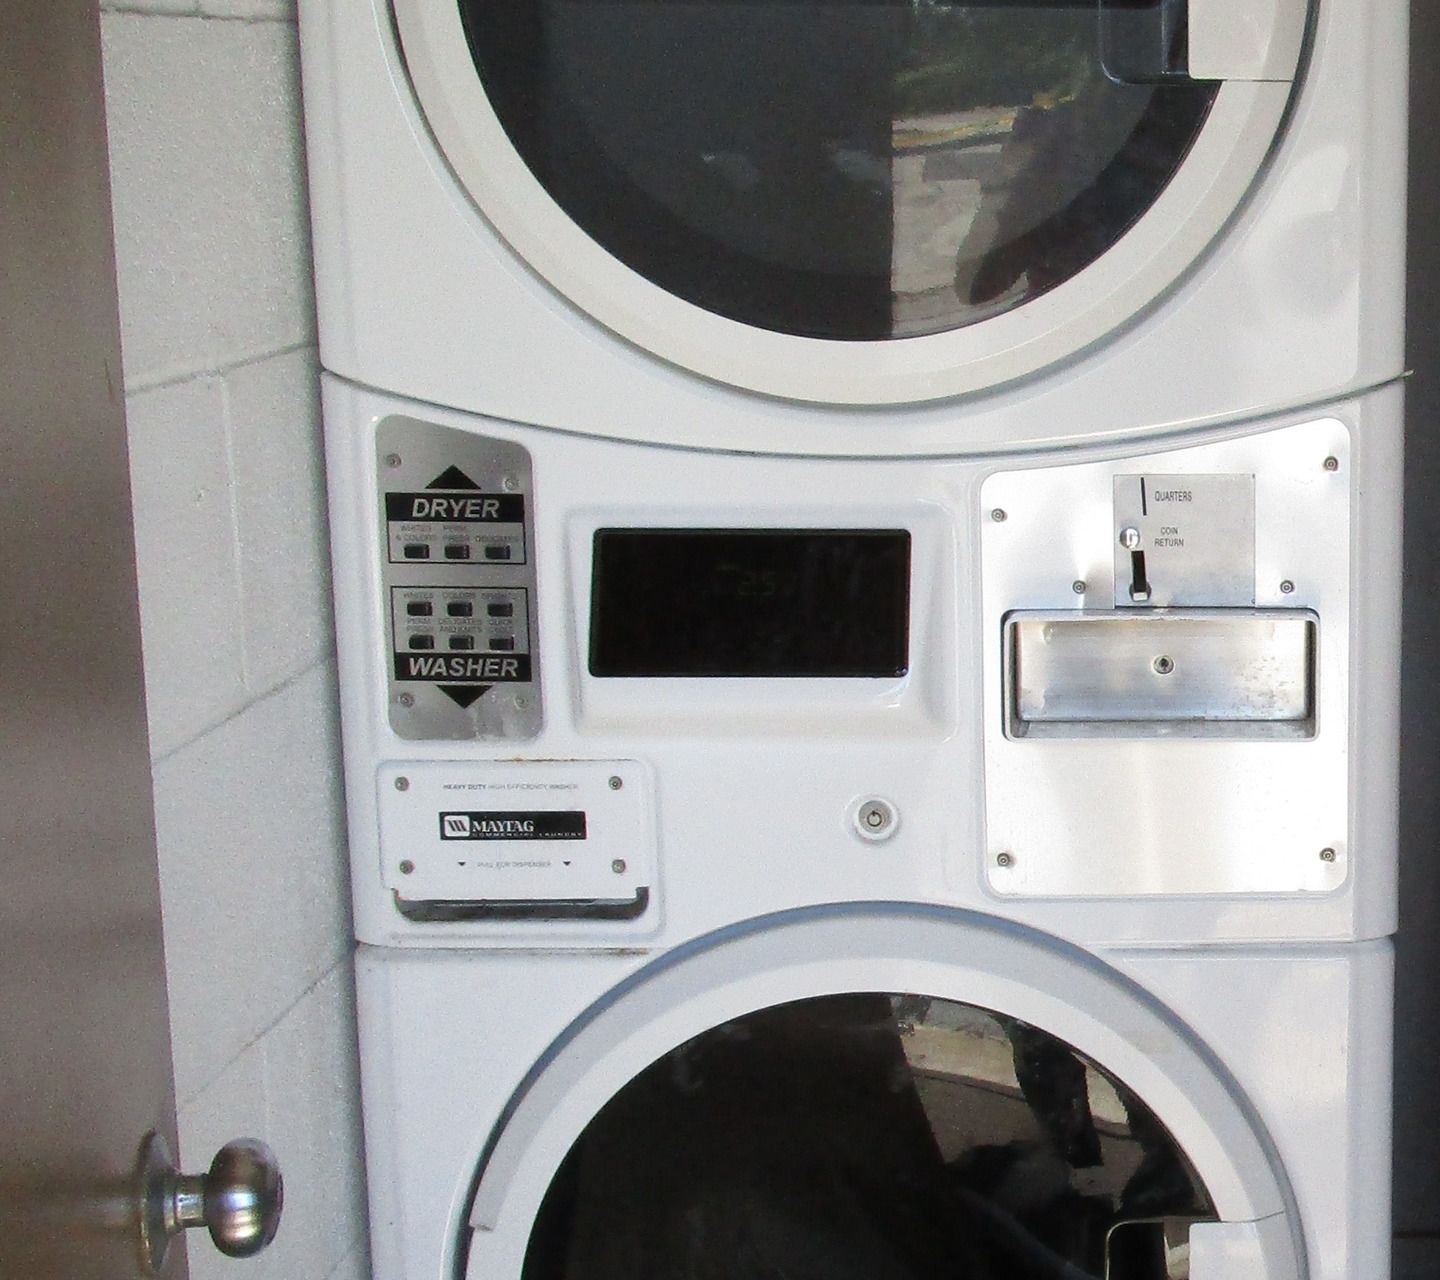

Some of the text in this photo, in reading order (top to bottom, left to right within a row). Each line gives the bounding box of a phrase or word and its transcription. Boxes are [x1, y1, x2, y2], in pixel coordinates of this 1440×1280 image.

[1154, 490, 1193, 503] QUARTERS
[411, 498, 500, 519] DRYER
[1160, 526, 1179, 536] COIN
[1154, 538, 1185, 548] RETURN
[408, 656, 518, 678] WASHER
[471, 820, 535, 833] MAYTAG
